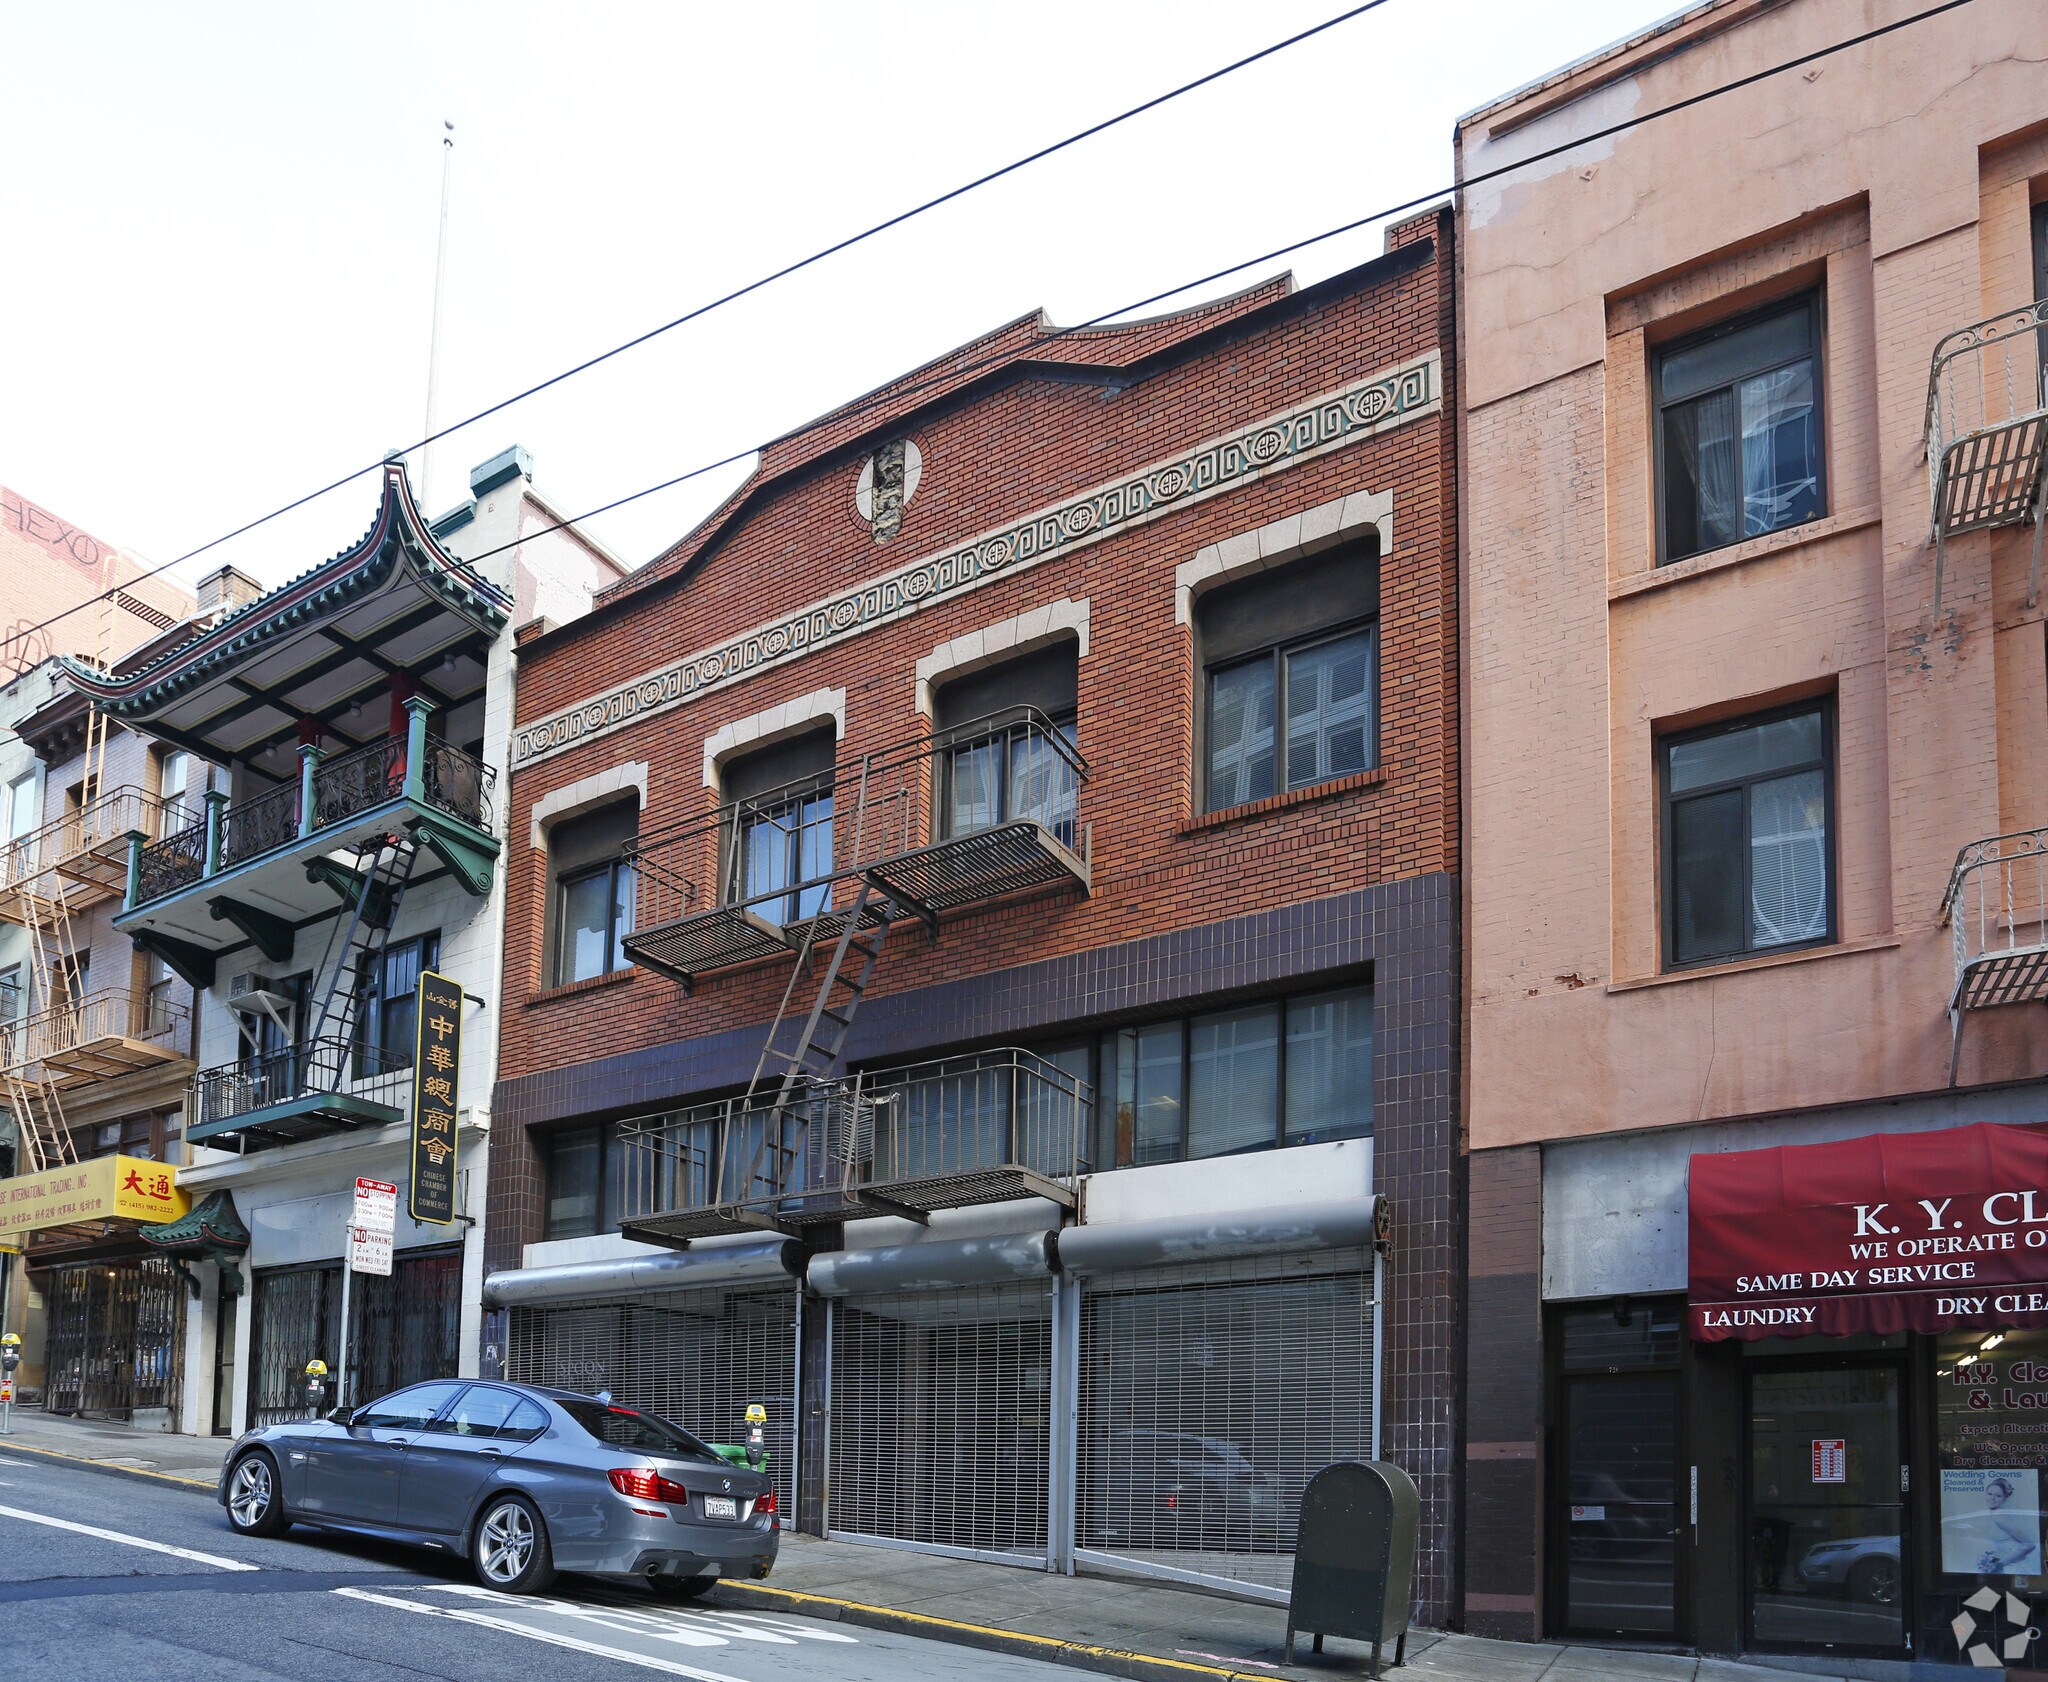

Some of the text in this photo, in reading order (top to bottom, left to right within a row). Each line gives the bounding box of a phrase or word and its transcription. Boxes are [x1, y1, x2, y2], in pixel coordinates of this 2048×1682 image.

[420, 1014, 455, 1165] 中華總商會
[423, 1170, 446, 1183] CHINESE
[10, 1183, 46, 1202] INTERNATIONAL
[122, 1169, 172, 1201] 大通
[361, 1180, 393, 1191] TOW-AWAY
[421, 1179, 447, 1192] CHAMBER
[357, 1186, 394, 1201] NO STOPPING
[430, 1190, 438, 1199] OF
[129, 1202, 145, 1210] (415)
[418, 1197, 449, 1211] COMMERCE
[1853, 1203, 1900, 1237] K.
[1917, 1197, 1963, 1231] Y.
[355, 1230, 392, 1246] NO PARKING
[1849, 1229, 2048, 1260] WE OPERATE O
[375, 1247, 381, 1255] 6
[1736, 1261, 1976, 1293] SAME DAY SERVICE
[1936, 1296, 1988, 1315] DRY
[1703, 1306, 1817, 1327] LAUNDRY
[1953, 1363, 1998, 1386] K.Y.
[1968, 1389, 1993, 1410] &
[1960, 1424, 2000, 1437] Expert
[1974, 1442, 1994, 1453] We
[1954, 1455, 1975, 1468] Dry
[1979, 1455, 2030, 1467] Cleaning
[1943, 1470, 2022, 1479] Wedding Gowns
